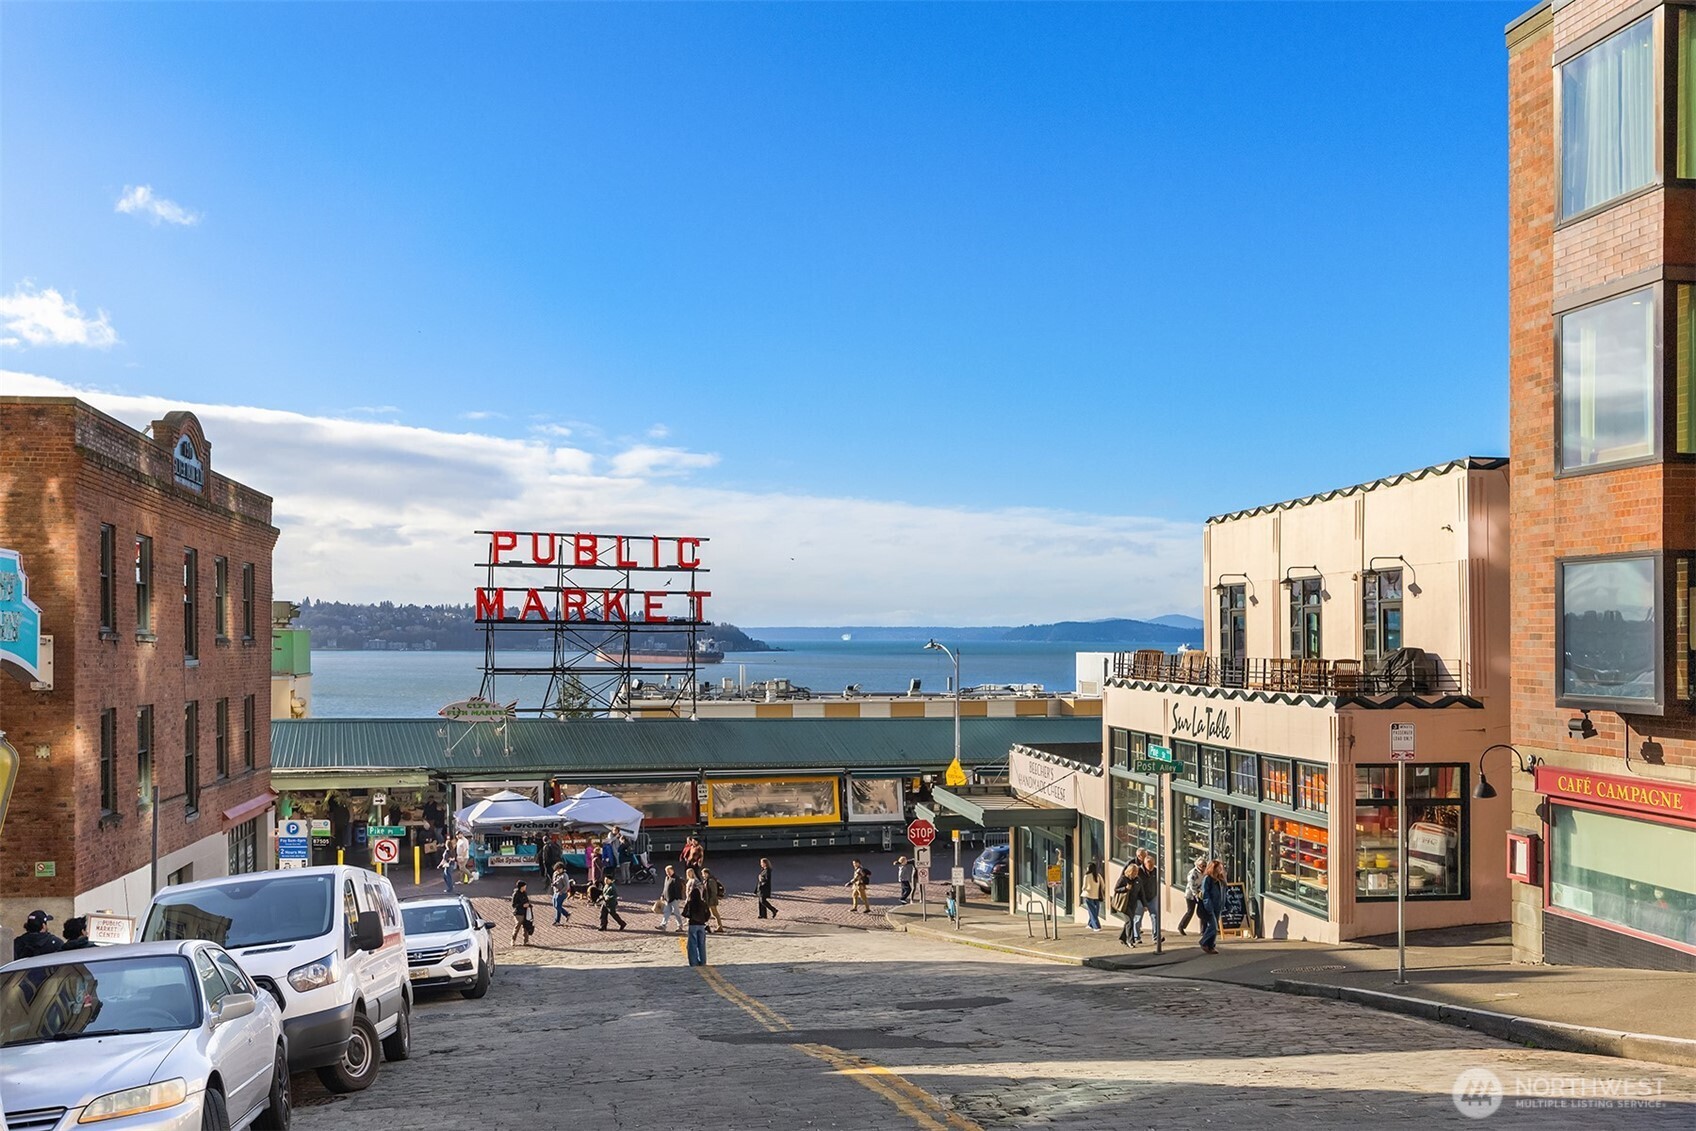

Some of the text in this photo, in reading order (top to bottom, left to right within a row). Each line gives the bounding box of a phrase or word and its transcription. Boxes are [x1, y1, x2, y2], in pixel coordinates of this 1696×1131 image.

[493, 531, 700, 568] PUBLIC
[476, 587, 711, 622] MARKET
[1171, 702, 1231, 740] Sur La Table
[1137, 761, 1155, 771] Post
[1160, 764, 1176, 772] Alley
[1047, 784, 1066, 802] CHEESE
[1557, 775, 1684, 811] CAFÉ CAMPAGNE
[369, 826, 385, 835] Pike
[513, 821, 559, 830] Orchards
[910, 828, 932, 838] STOP
